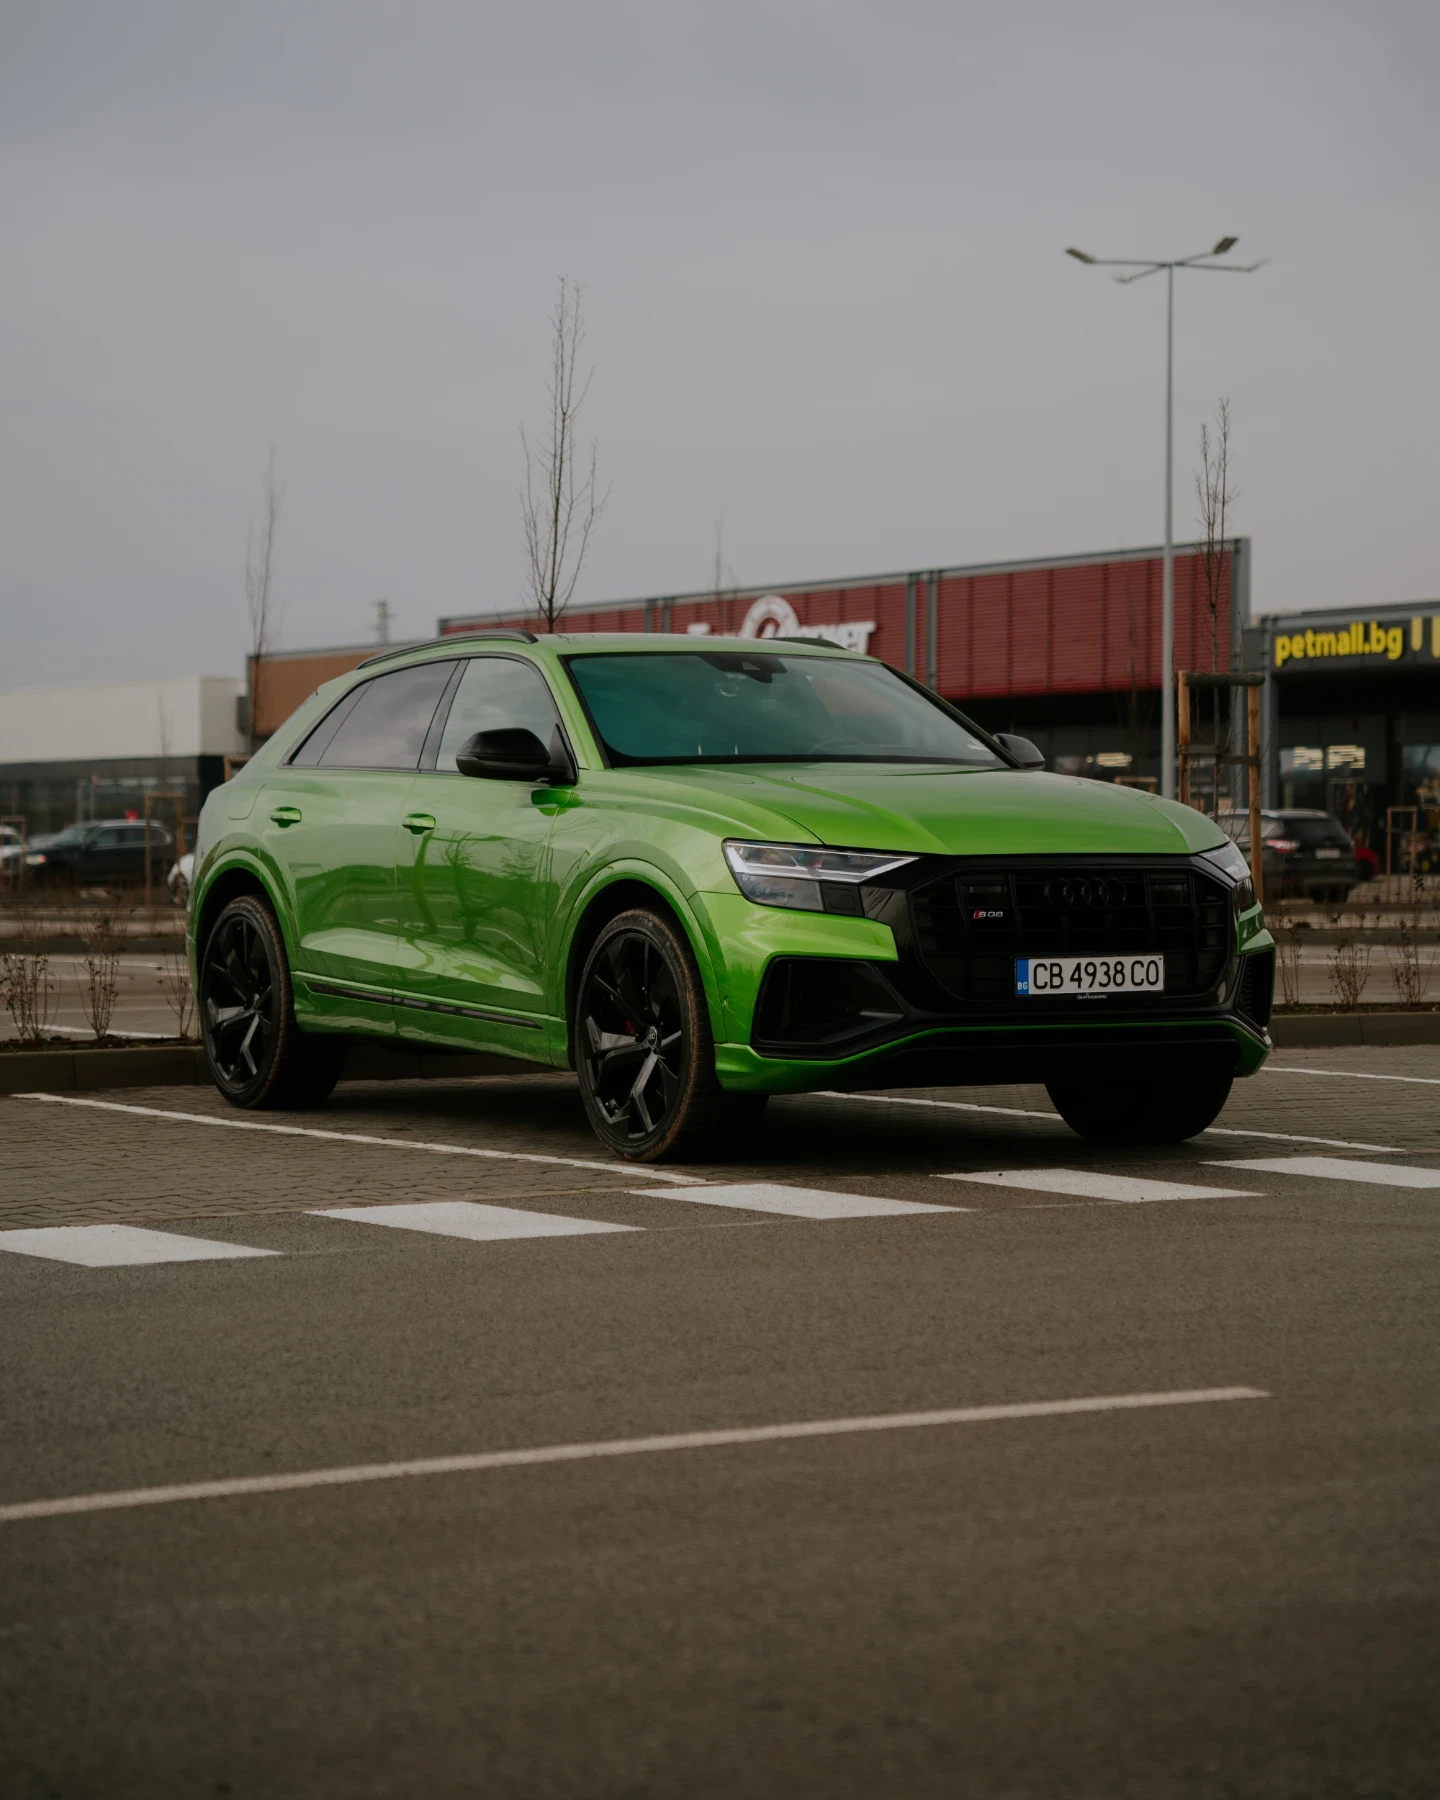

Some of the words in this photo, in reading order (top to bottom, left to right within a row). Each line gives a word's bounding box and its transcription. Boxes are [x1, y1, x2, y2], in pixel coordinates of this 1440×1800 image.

[1274, 620, 1403, 667] petmall.bg
[1017, 981, 1028, 990] BG
[1033, 962, 1064, 990] CB
[1069, 960, 1126, 989] 4938
[1130, 959, 1160, 987] CO
